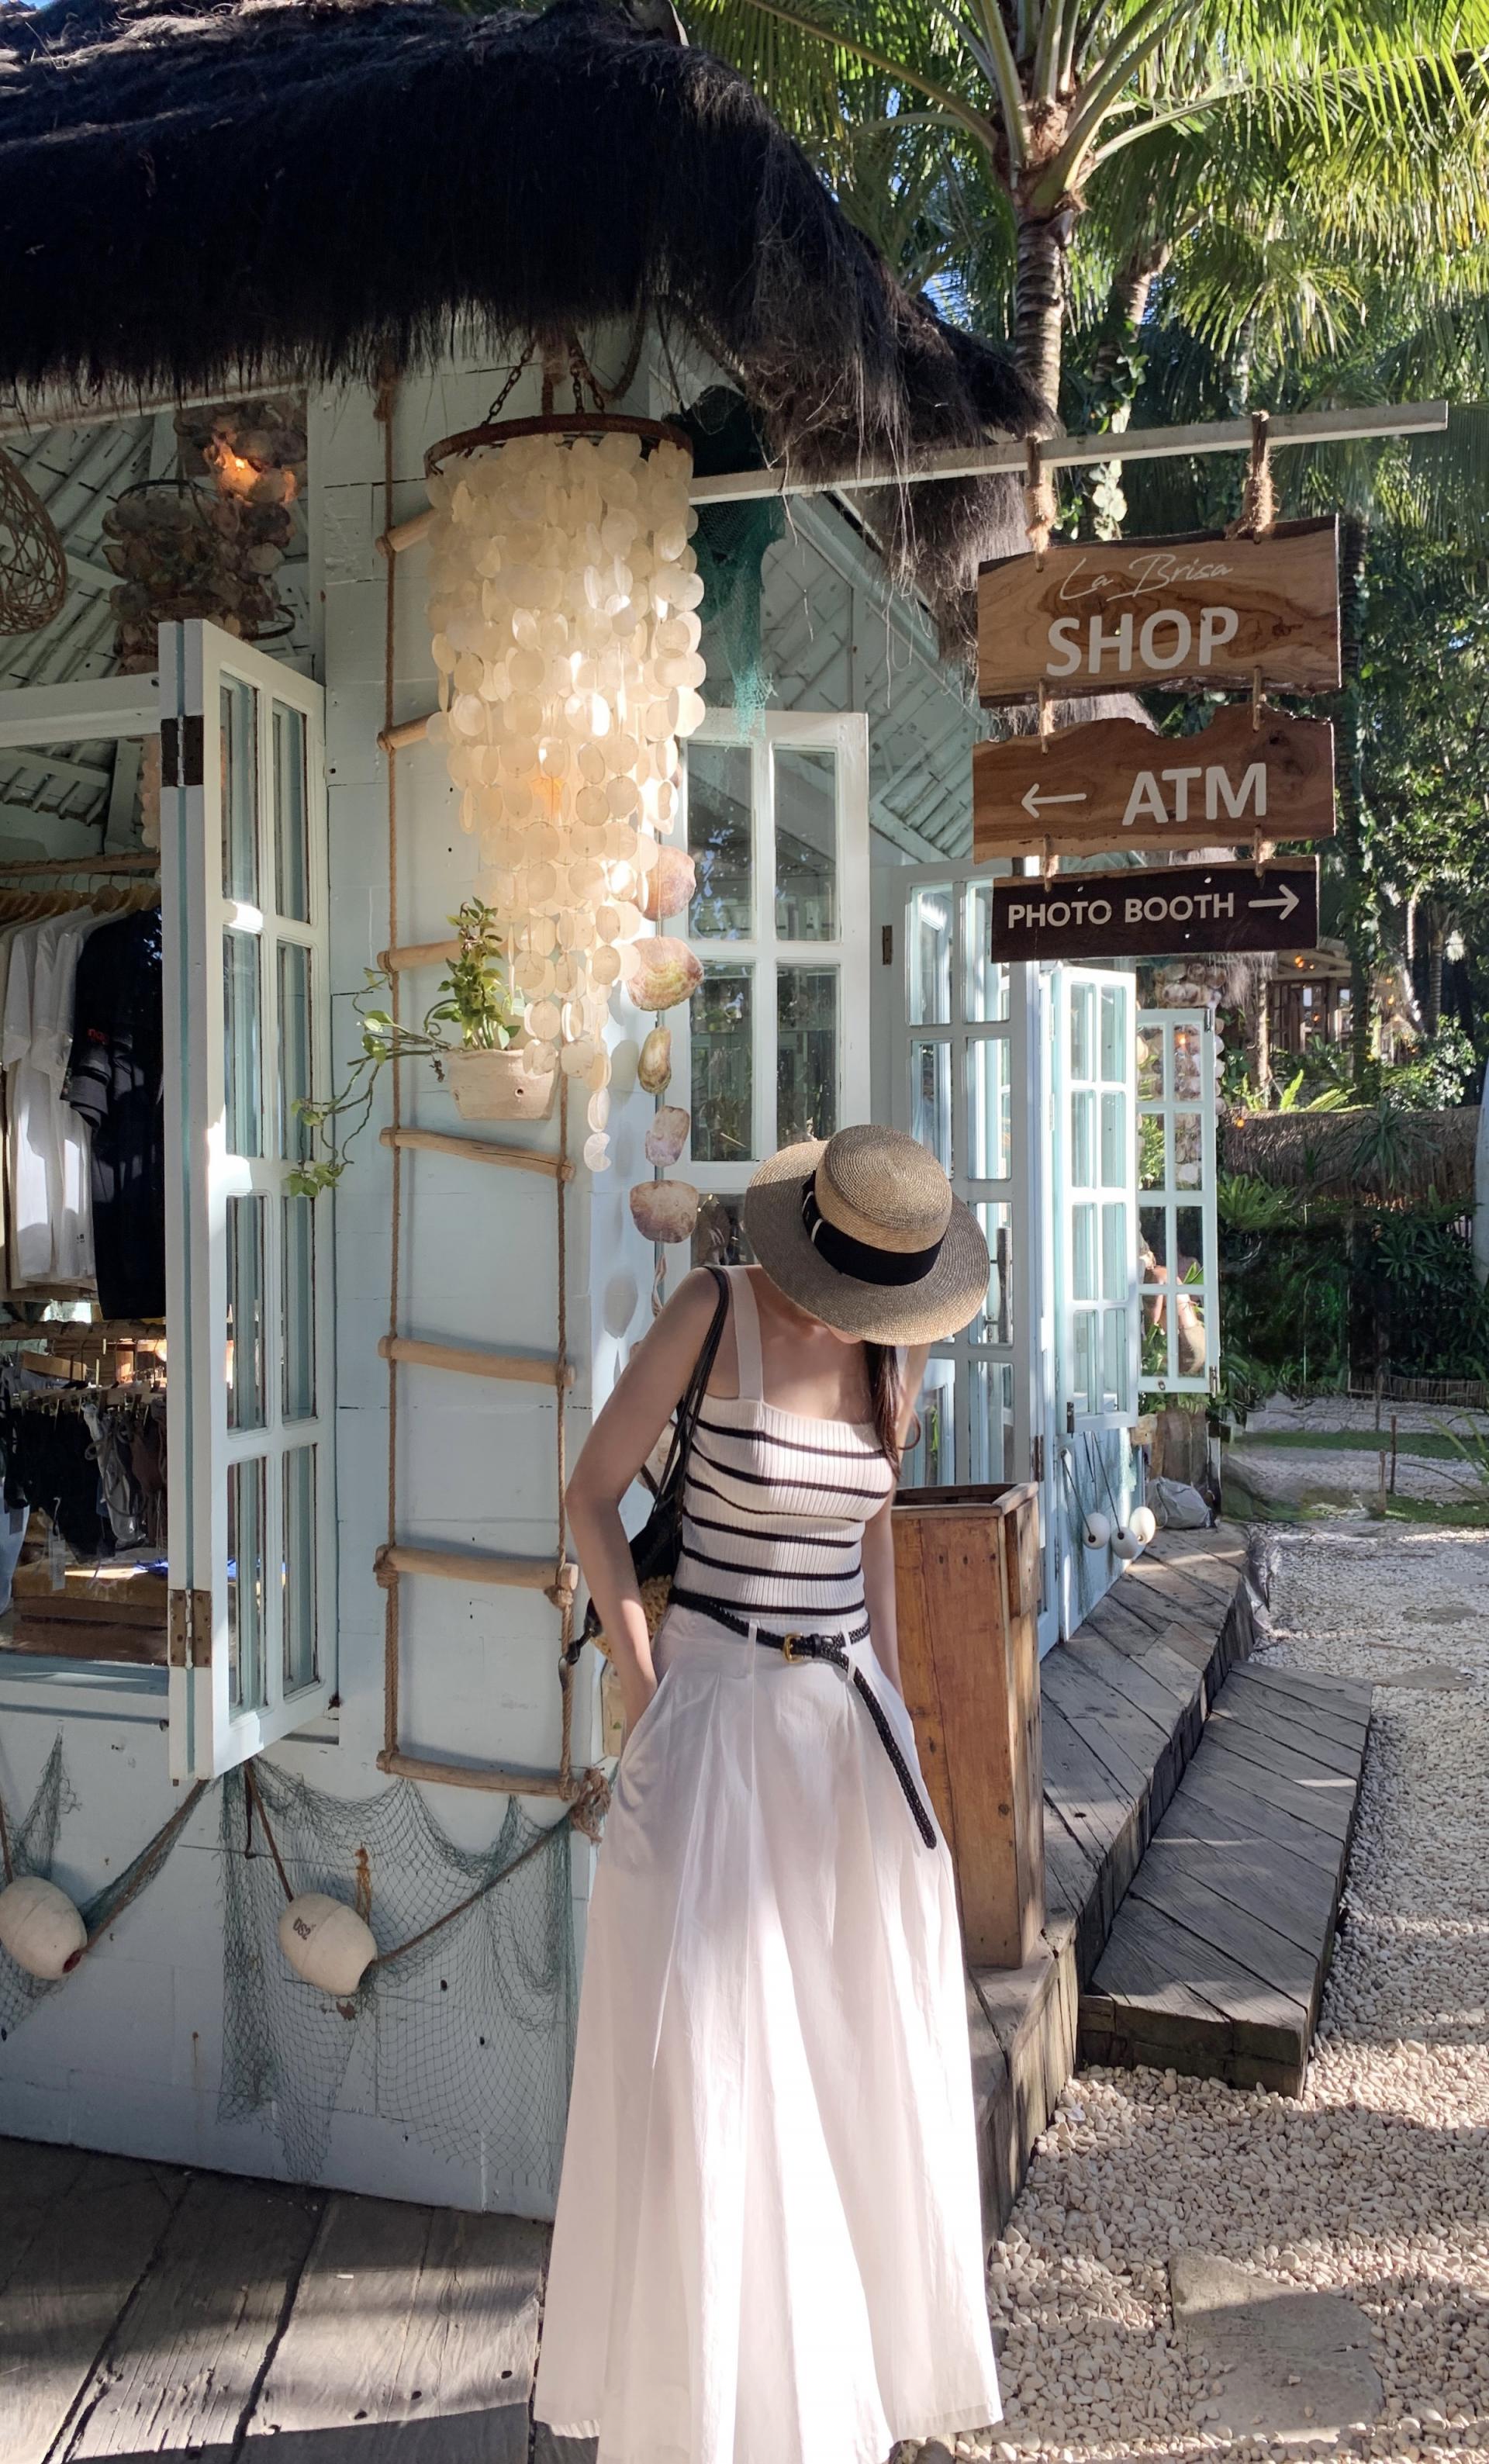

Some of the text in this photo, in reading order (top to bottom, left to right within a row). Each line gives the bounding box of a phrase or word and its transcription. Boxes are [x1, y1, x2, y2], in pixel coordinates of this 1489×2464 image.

[1059, 554, 1233, 602] La Brisa
[1046, 606, 1239, 676] SHOP
[1122, 763, 1266, 825] ATM
[1007, 893, 1235, 928] PHOTO BOOTH
